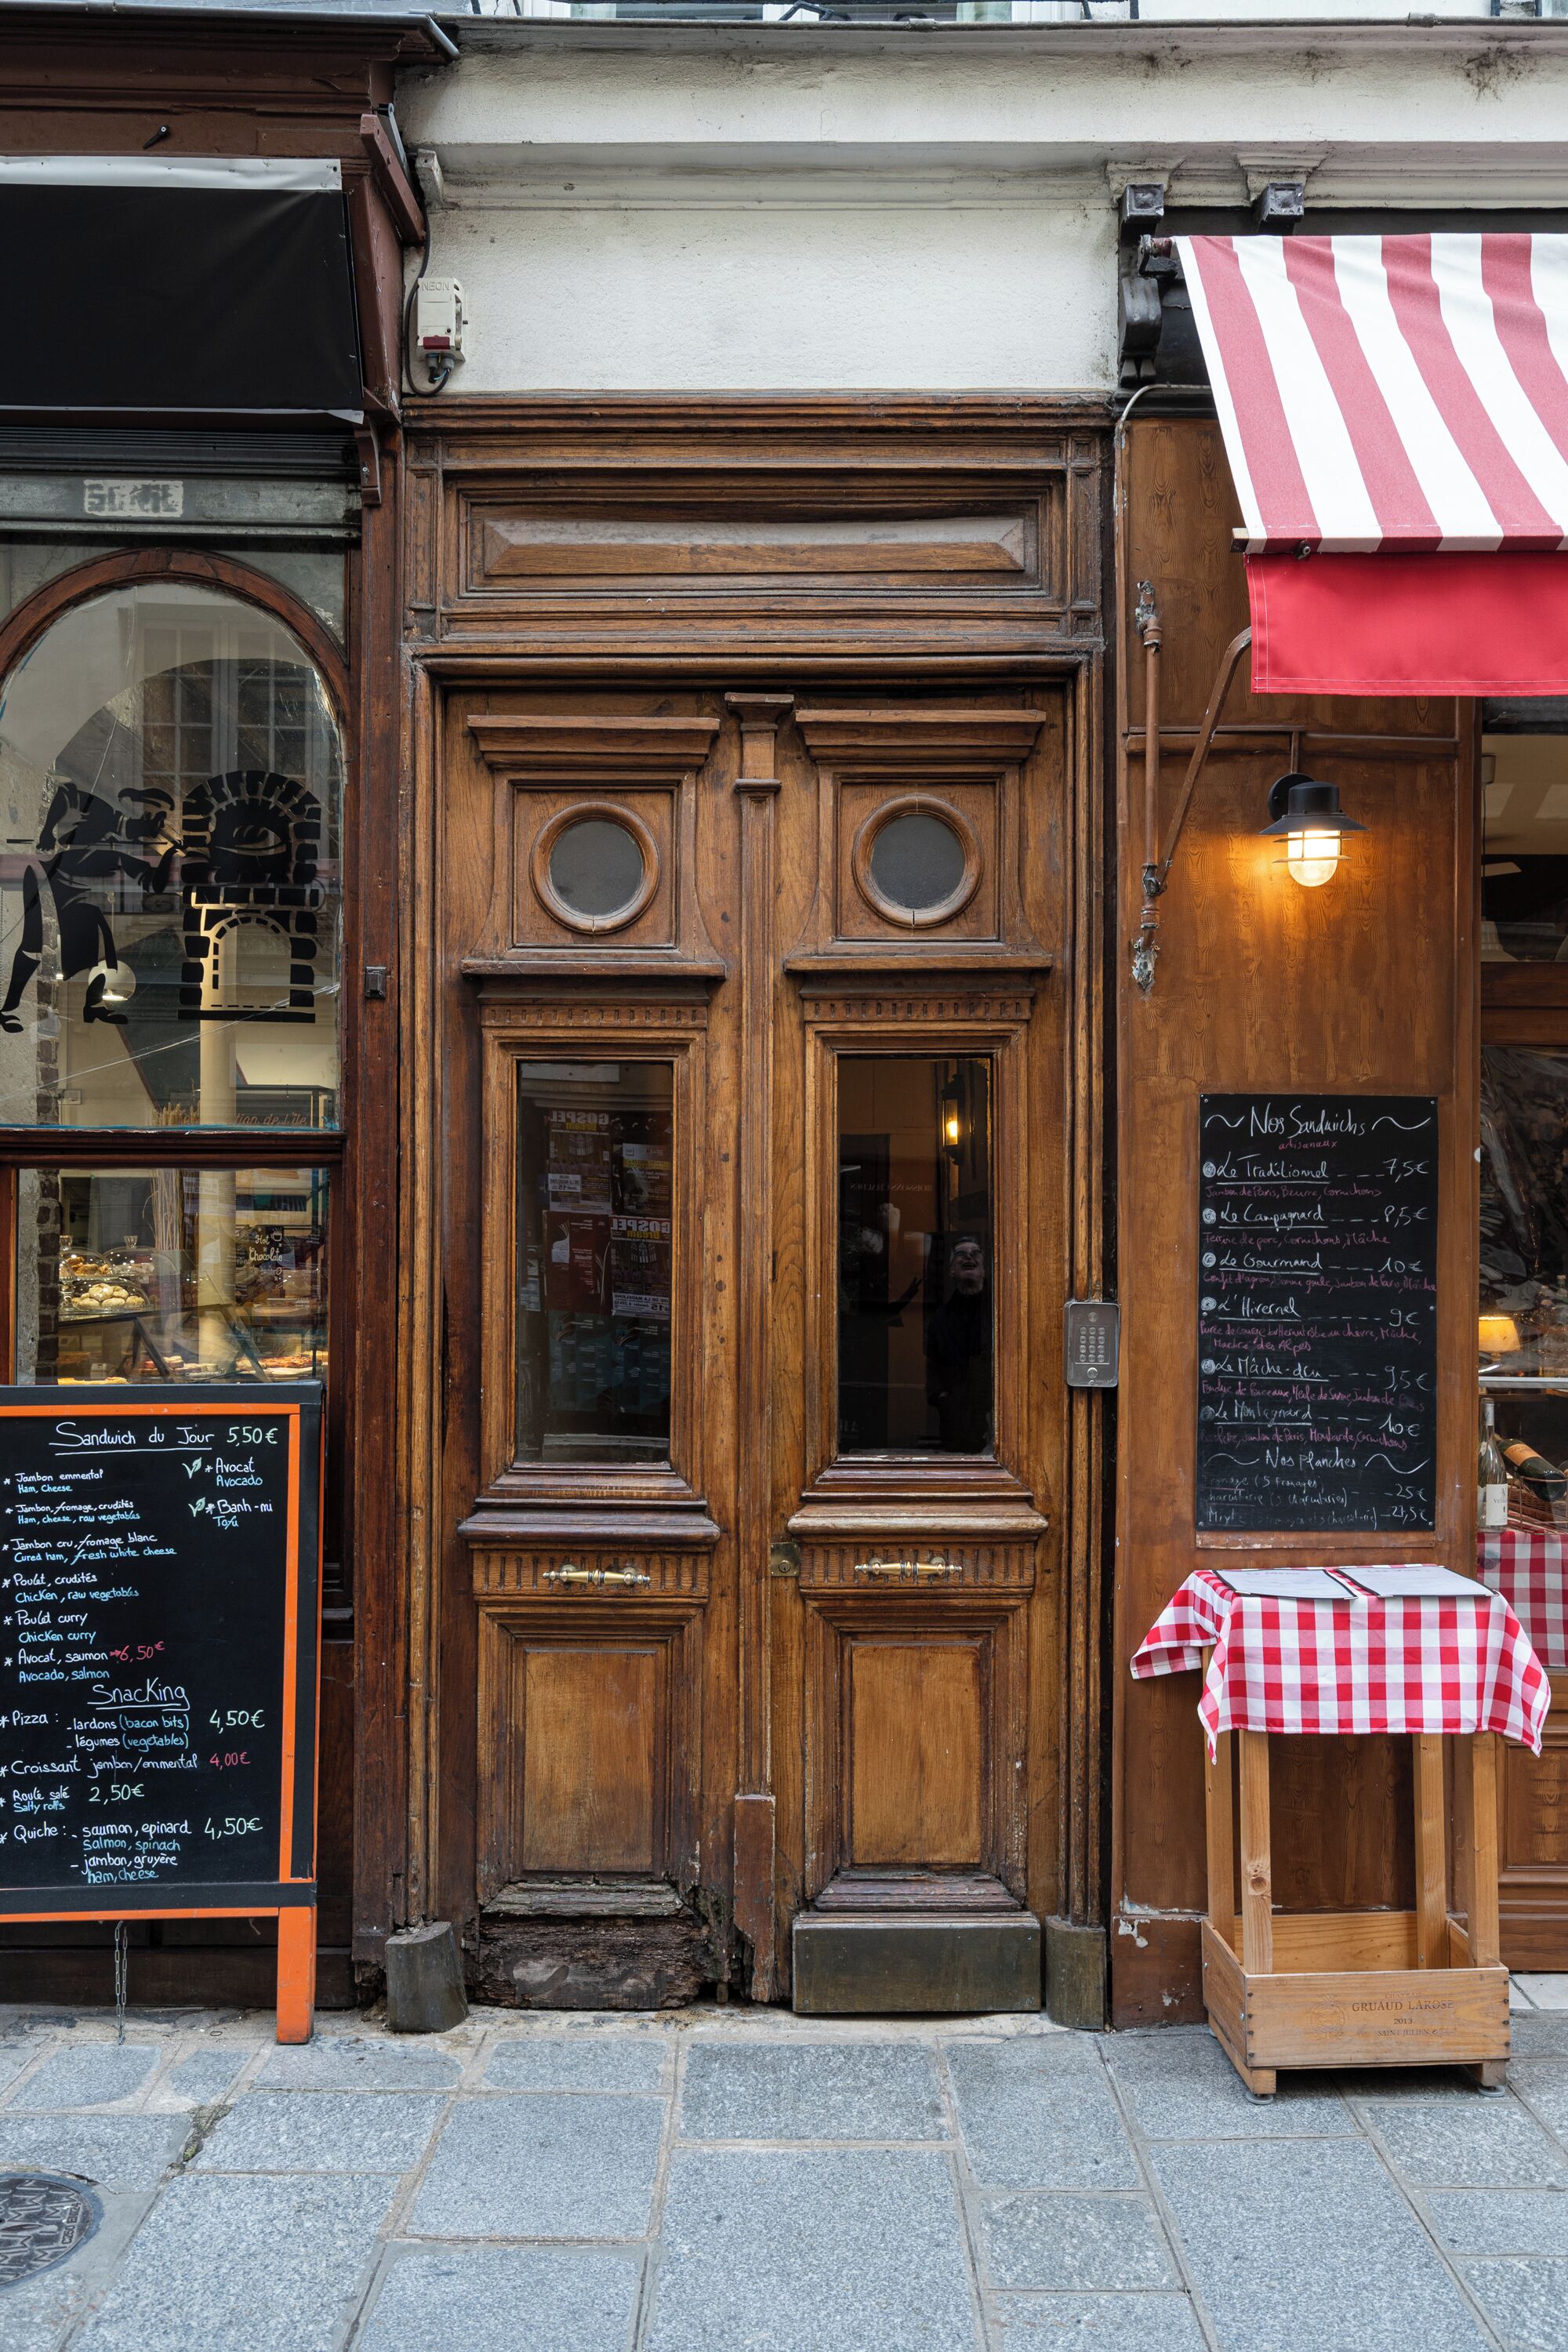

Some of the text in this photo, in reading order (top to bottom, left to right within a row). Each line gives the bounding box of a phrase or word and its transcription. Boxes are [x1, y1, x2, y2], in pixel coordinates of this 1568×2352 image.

[422, 282, 450, 291] NEON
[1250, 1102, 1284, 1136] Nos
[1217, 1151, 1236, 1178] Le
[1221, 1202, 1240, 1223] Le
[255, 1235, 270, 1245] Hot
[249, 1247, 283, 1262] Chocolate
[1220, 1250, 1236, 1268] Le
[1216, 1355, 1233, 1372] Le
[49, 1421, 278, 1447] Sandwich du Jour 5,50€
[216, 1457, 255, 1474] Avocat
[1265, 1446, 1294, 1468] Nos
[15, 1468, 104, 1483] Jambon emmental
[216, 1475, 263, 1486] Avocado
[18, 1484, 38, 1494] Ham,
[98, 1499, 134, 1510] crudités
[97, 1510, 140, 1524] vegetables
[212, 1515, 238, 1530] Tofu
[10, 1538, 52, 1551] Jambon
[77, 1534, 124, 1550] fromage
[128, 1532, 158, 1543] blanc
[14, 1547, 177, 1566] Cured ham, fresh white cheese
[54, 1573, 98, 1584] crudités
[89, 1587, 140, 1602] vegetables
[14, 1610, 88, 1627] Poulet curry
[67, 1632, 96, 1645] curry
[65, 1652, 108, 1662] saumon
[119, 1641, 165, 1663] 6,50€
[19, 1666, 110, 1683] Avocado, salmon
[119, 1714, 158, 1732] (bacon
[162, 1714, 190, 1731] bits)
[209, 1708, 265, 1734] 4,50€
[75, 1733, 189, 1752] légumes (vegetables)
[10, 1755, 82, 1775] Croissant
[209, 1751, 252, 1770] 4,00€
[13, 1784, 145, 1806] Roulé salé 2,50€
[13, 1802, 66, 1815] Salty rolls
[82, 1817, 263, 1840] saumon, epinard 4,50€
[135, 1838, 181, 1854] spinach
[81, 1853, 178, 1875] jambon, gruyère
[118, 1868, 158, 1880] cheese
[1352, 1999, 1454, 2013] GRUAUD LAROSE
